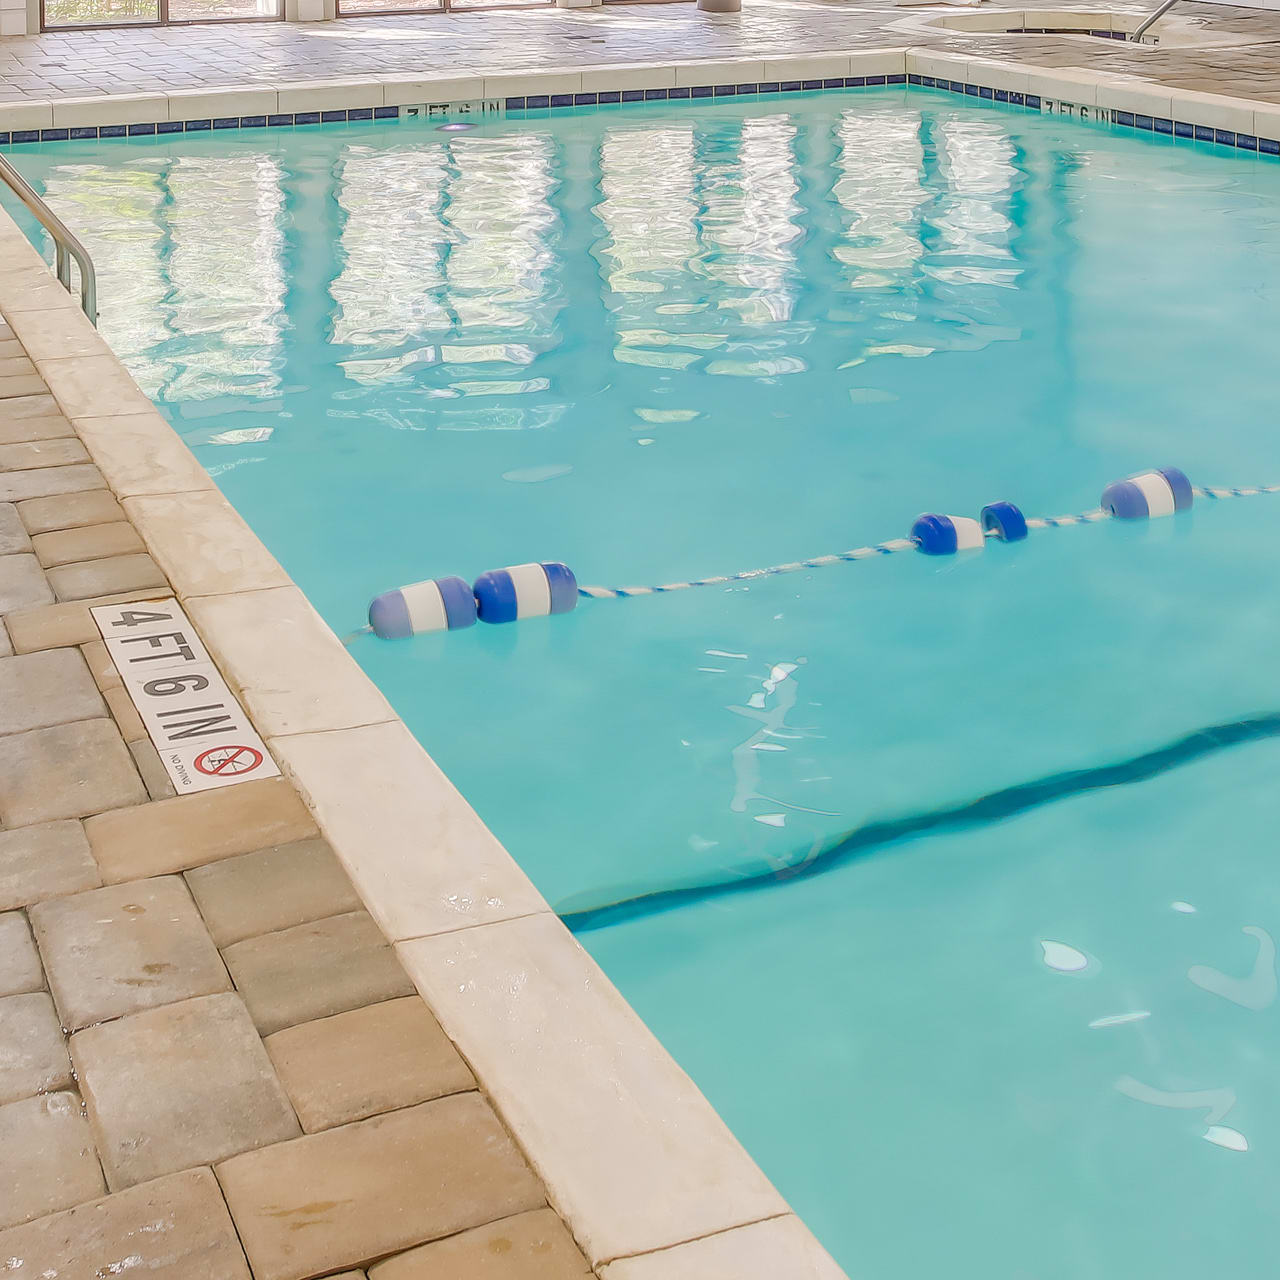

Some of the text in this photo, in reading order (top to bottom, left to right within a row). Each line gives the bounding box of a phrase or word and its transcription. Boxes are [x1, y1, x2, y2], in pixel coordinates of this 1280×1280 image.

[111, 610, 238, 742] 4 FT 6 IN
[171, 753, 193, 787] NO DIVING
